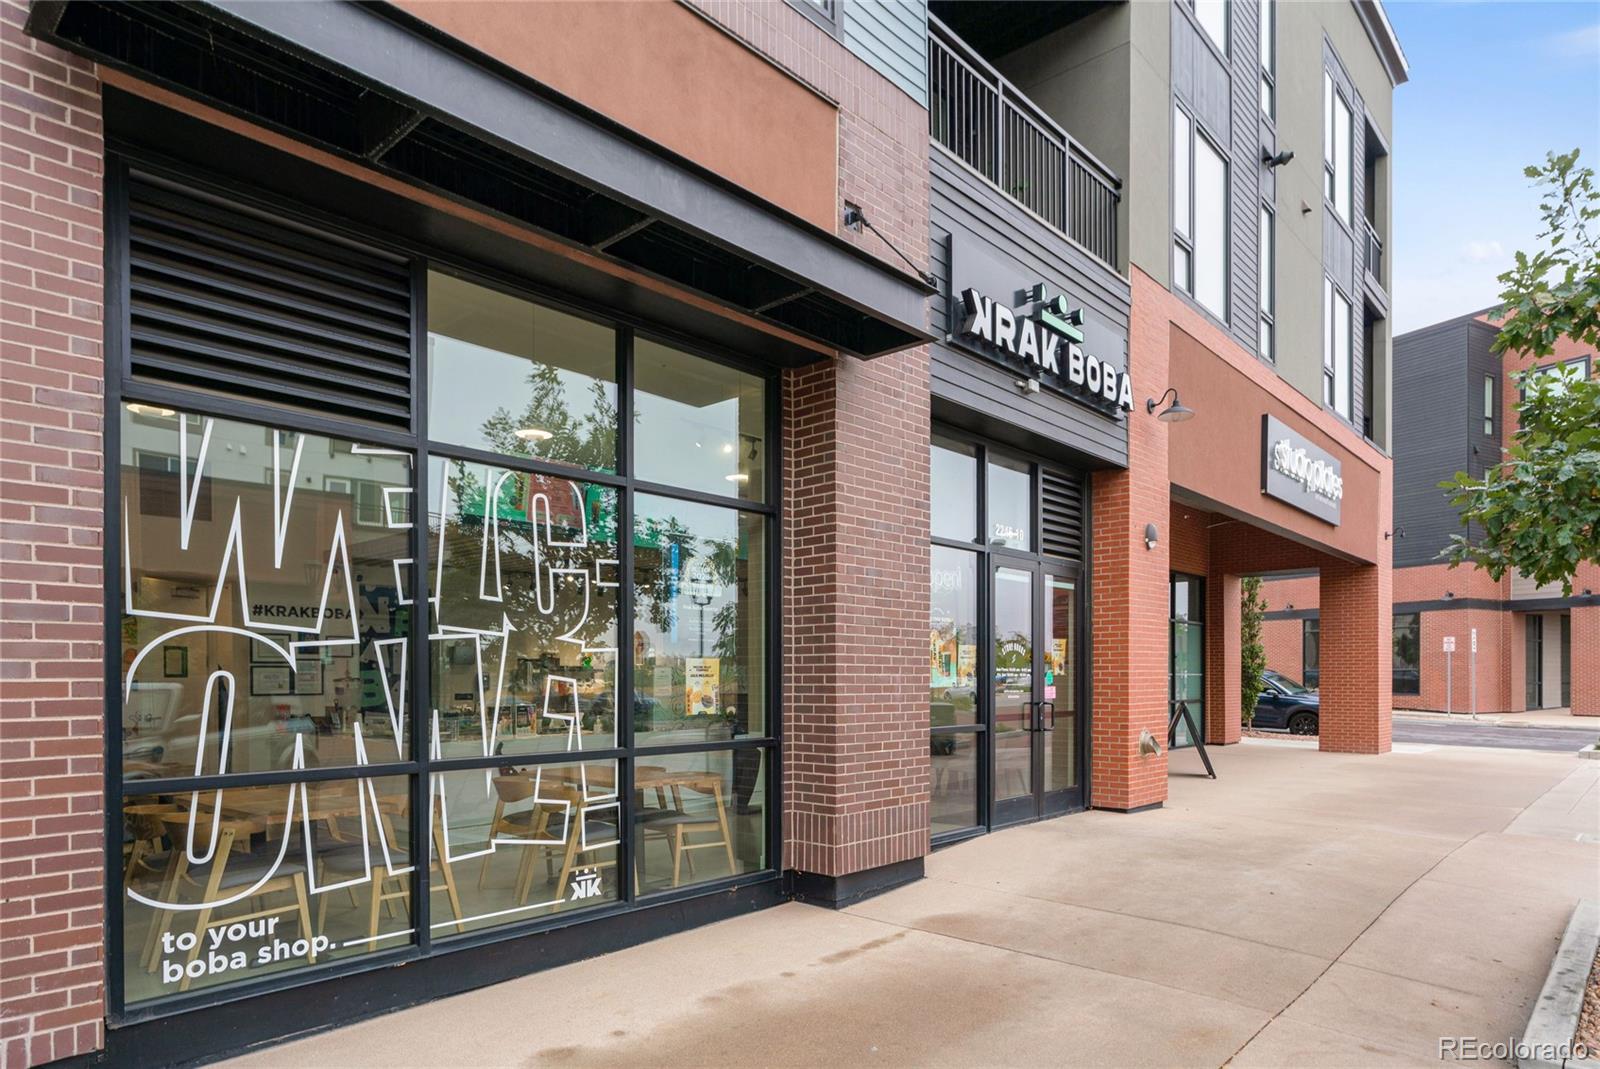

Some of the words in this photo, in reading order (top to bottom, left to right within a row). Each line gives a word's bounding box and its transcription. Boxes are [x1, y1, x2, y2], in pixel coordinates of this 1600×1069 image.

[963, 287, 1060, 375] KRAK
[1067, 341, 1135, 411] BOBA
[161, 931, 197, 954] to
[208, 916, 280, 949] your
[162, 951, 247, 984] boba
[257, 934, 336, 965] shop.
